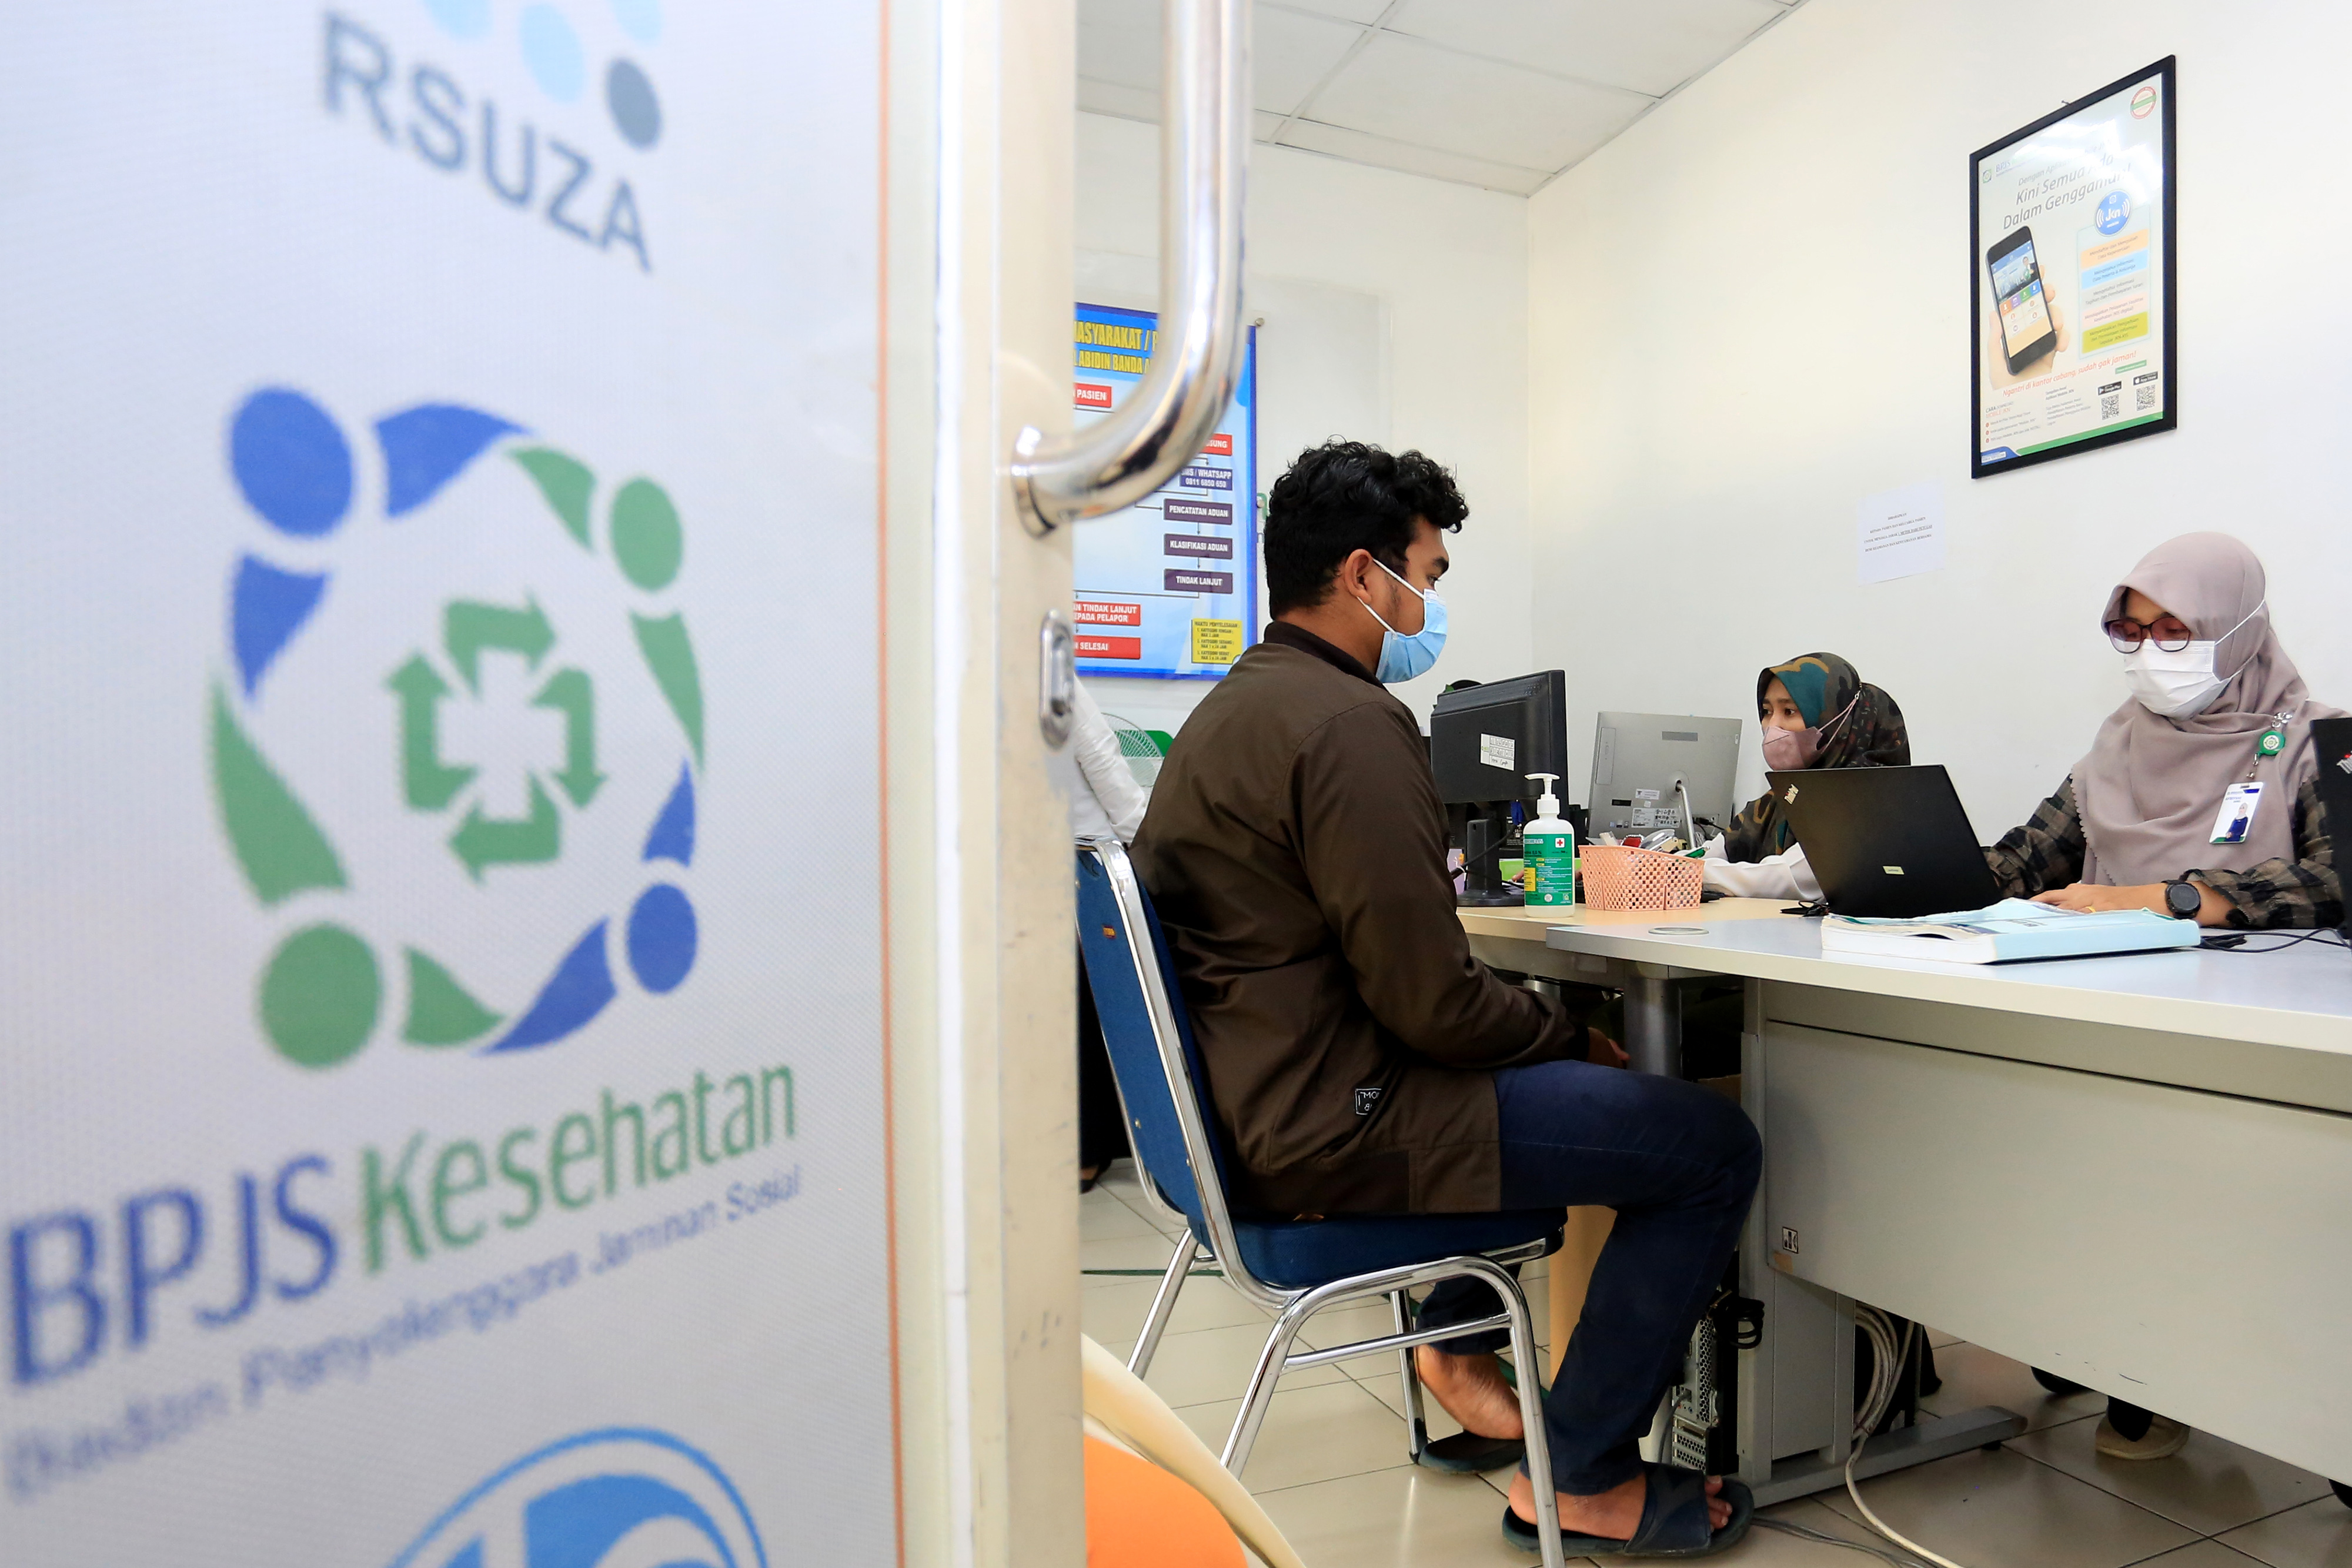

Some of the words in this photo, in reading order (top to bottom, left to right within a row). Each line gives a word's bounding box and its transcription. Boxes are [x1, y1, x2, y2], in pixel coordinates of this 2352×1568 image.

[321, 7, 652, 274] RSUZA
[2016, 183, 2039, 205] Kini
[2042, 166, 2085, 195] Semua
[2003, 202, 2042, 230] Dalam
[1078, 349, 1111, 370] ABIDIN
[1112, 353, 1143, 375] BANDA
[2003, 383, 2024, 397] Ngantri
[2033, 377, 2053, 388] kantor
[2053, 370, 2077, 382] cabang,
[2078, 362, 2097, 375] sudah
[2097, 357, 2110, 369] gak
[2111, 350, 2137, 365] jaman!
[1077, 389, 1107, 401] PASIEN
[1198, 469, 1232, 479] WHATSAPP
[1169, 505, 1206, 516] PENCATATAN
[1208, 508, 1228, 517] ADUAN
[1170, 540, 1207, 550] KLASIFIKASI
[1207, 543, 1228, 551] ADUAN
[1175, 576, 1198, 585] TINDAK
[1199, 577, 1223, 586] LANJUT
[1083, 604, 1108, 613] TINDAK
[1110, 605, 1137, 614] LANJUT
[1097, 613, 1128, 622] PELAPOR
[1080, 641, 1109, 651] SELESAI
[6, 1152, 342, 1393] BPJS
[358, 1062, 797, 1278] Kesehatan
